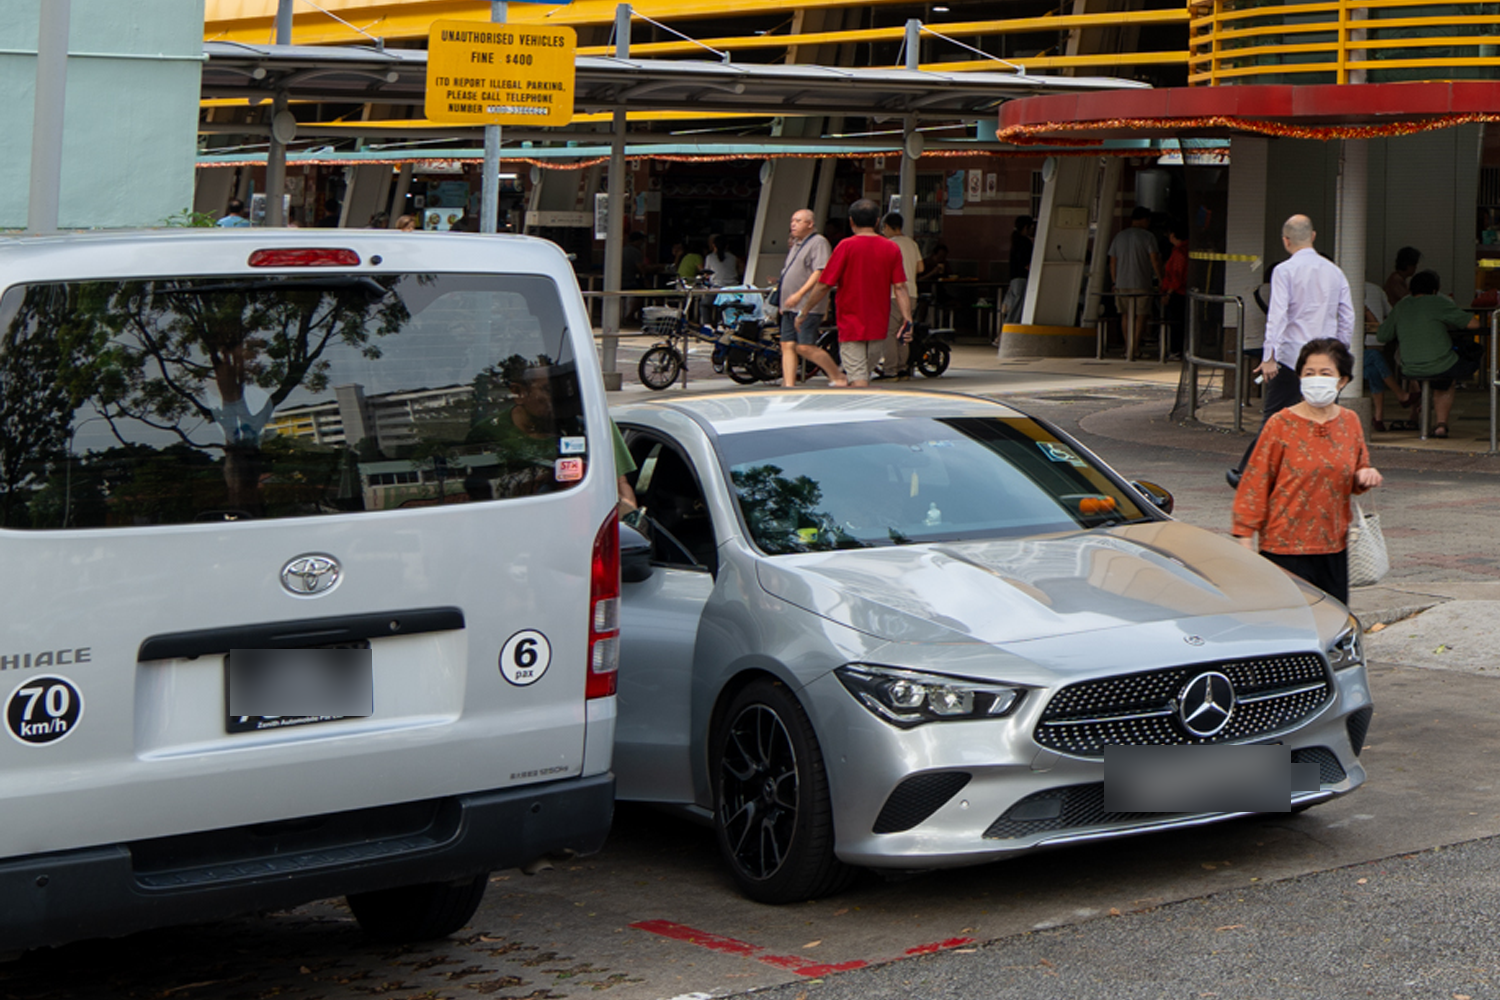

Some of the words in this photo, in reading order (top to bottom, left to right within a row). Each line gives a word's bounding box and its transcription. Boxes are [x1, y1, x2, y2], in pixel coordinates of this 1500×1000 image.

[441, 30, 514, 45] UNAUTHORISED
[519, 34, 565, 48] VEHICLES
[471, 51, 495, 64] FINE
[505, 53, 534, 66] $400
[453, 77, 487, 89] REPORT
[489, 78, 523, 90] ILLEGAL
[446, 90, 478, 101] PLEASE
[481, 91, 502, 102] CALL
[506, 92, 554, 104] TELEPHONE
[447, 103, 484, 114] NUMBER
[0, 647, 92, 671] HIACE
[514, 637, 539, 669] 6
[515, 669, 535, 681] pax
[19, 684, 70, 720] 70
[20, 717, 68, 736] km/h
